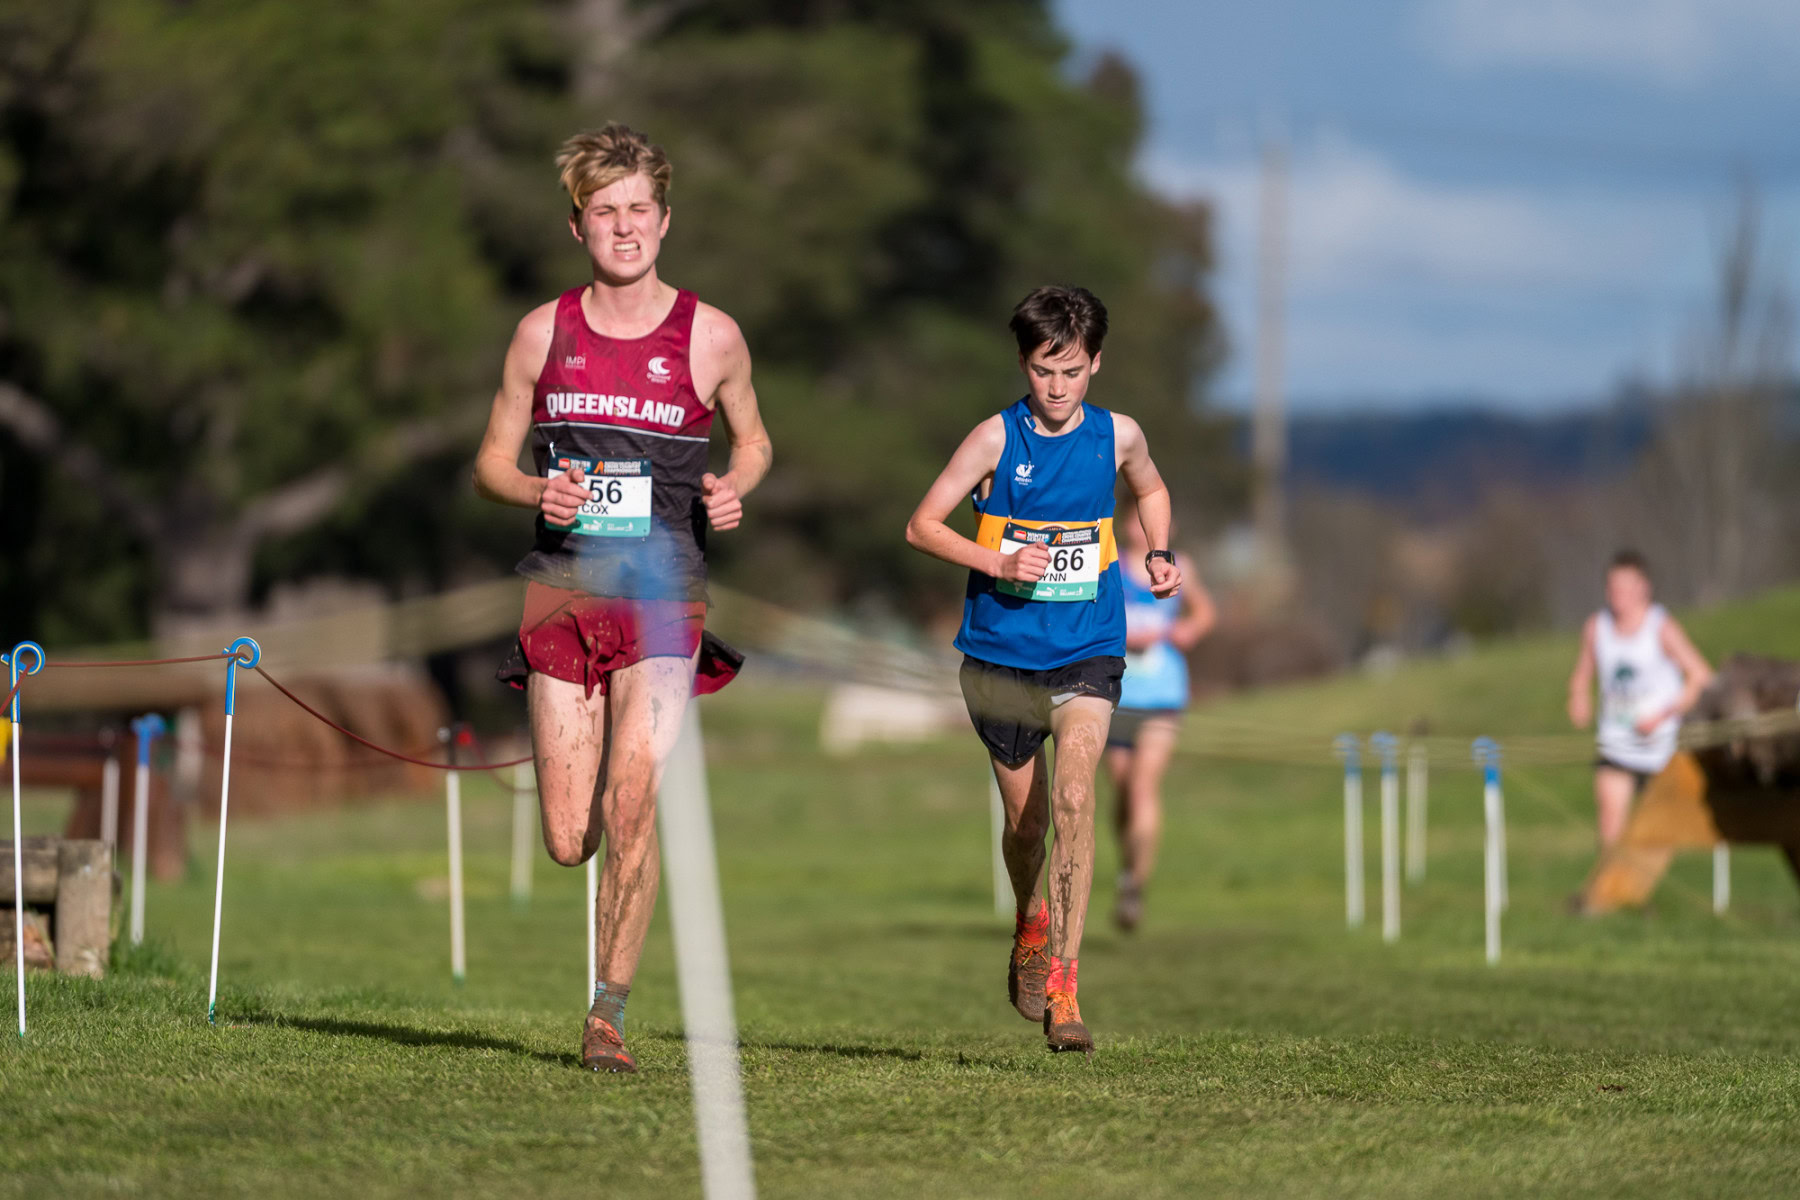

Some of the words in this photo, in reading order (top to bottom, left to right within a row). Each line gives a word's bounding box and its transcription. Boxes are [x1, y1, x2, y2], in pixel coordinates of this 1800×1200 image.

[546, 392, 685, 427] QUEENSLAND
[589, 479, 622, 503] 56
[581, 504, 608, 514] COX
[1053, 548, 1084, 571] 66
[1039, 573, 1066, 581] YNN
